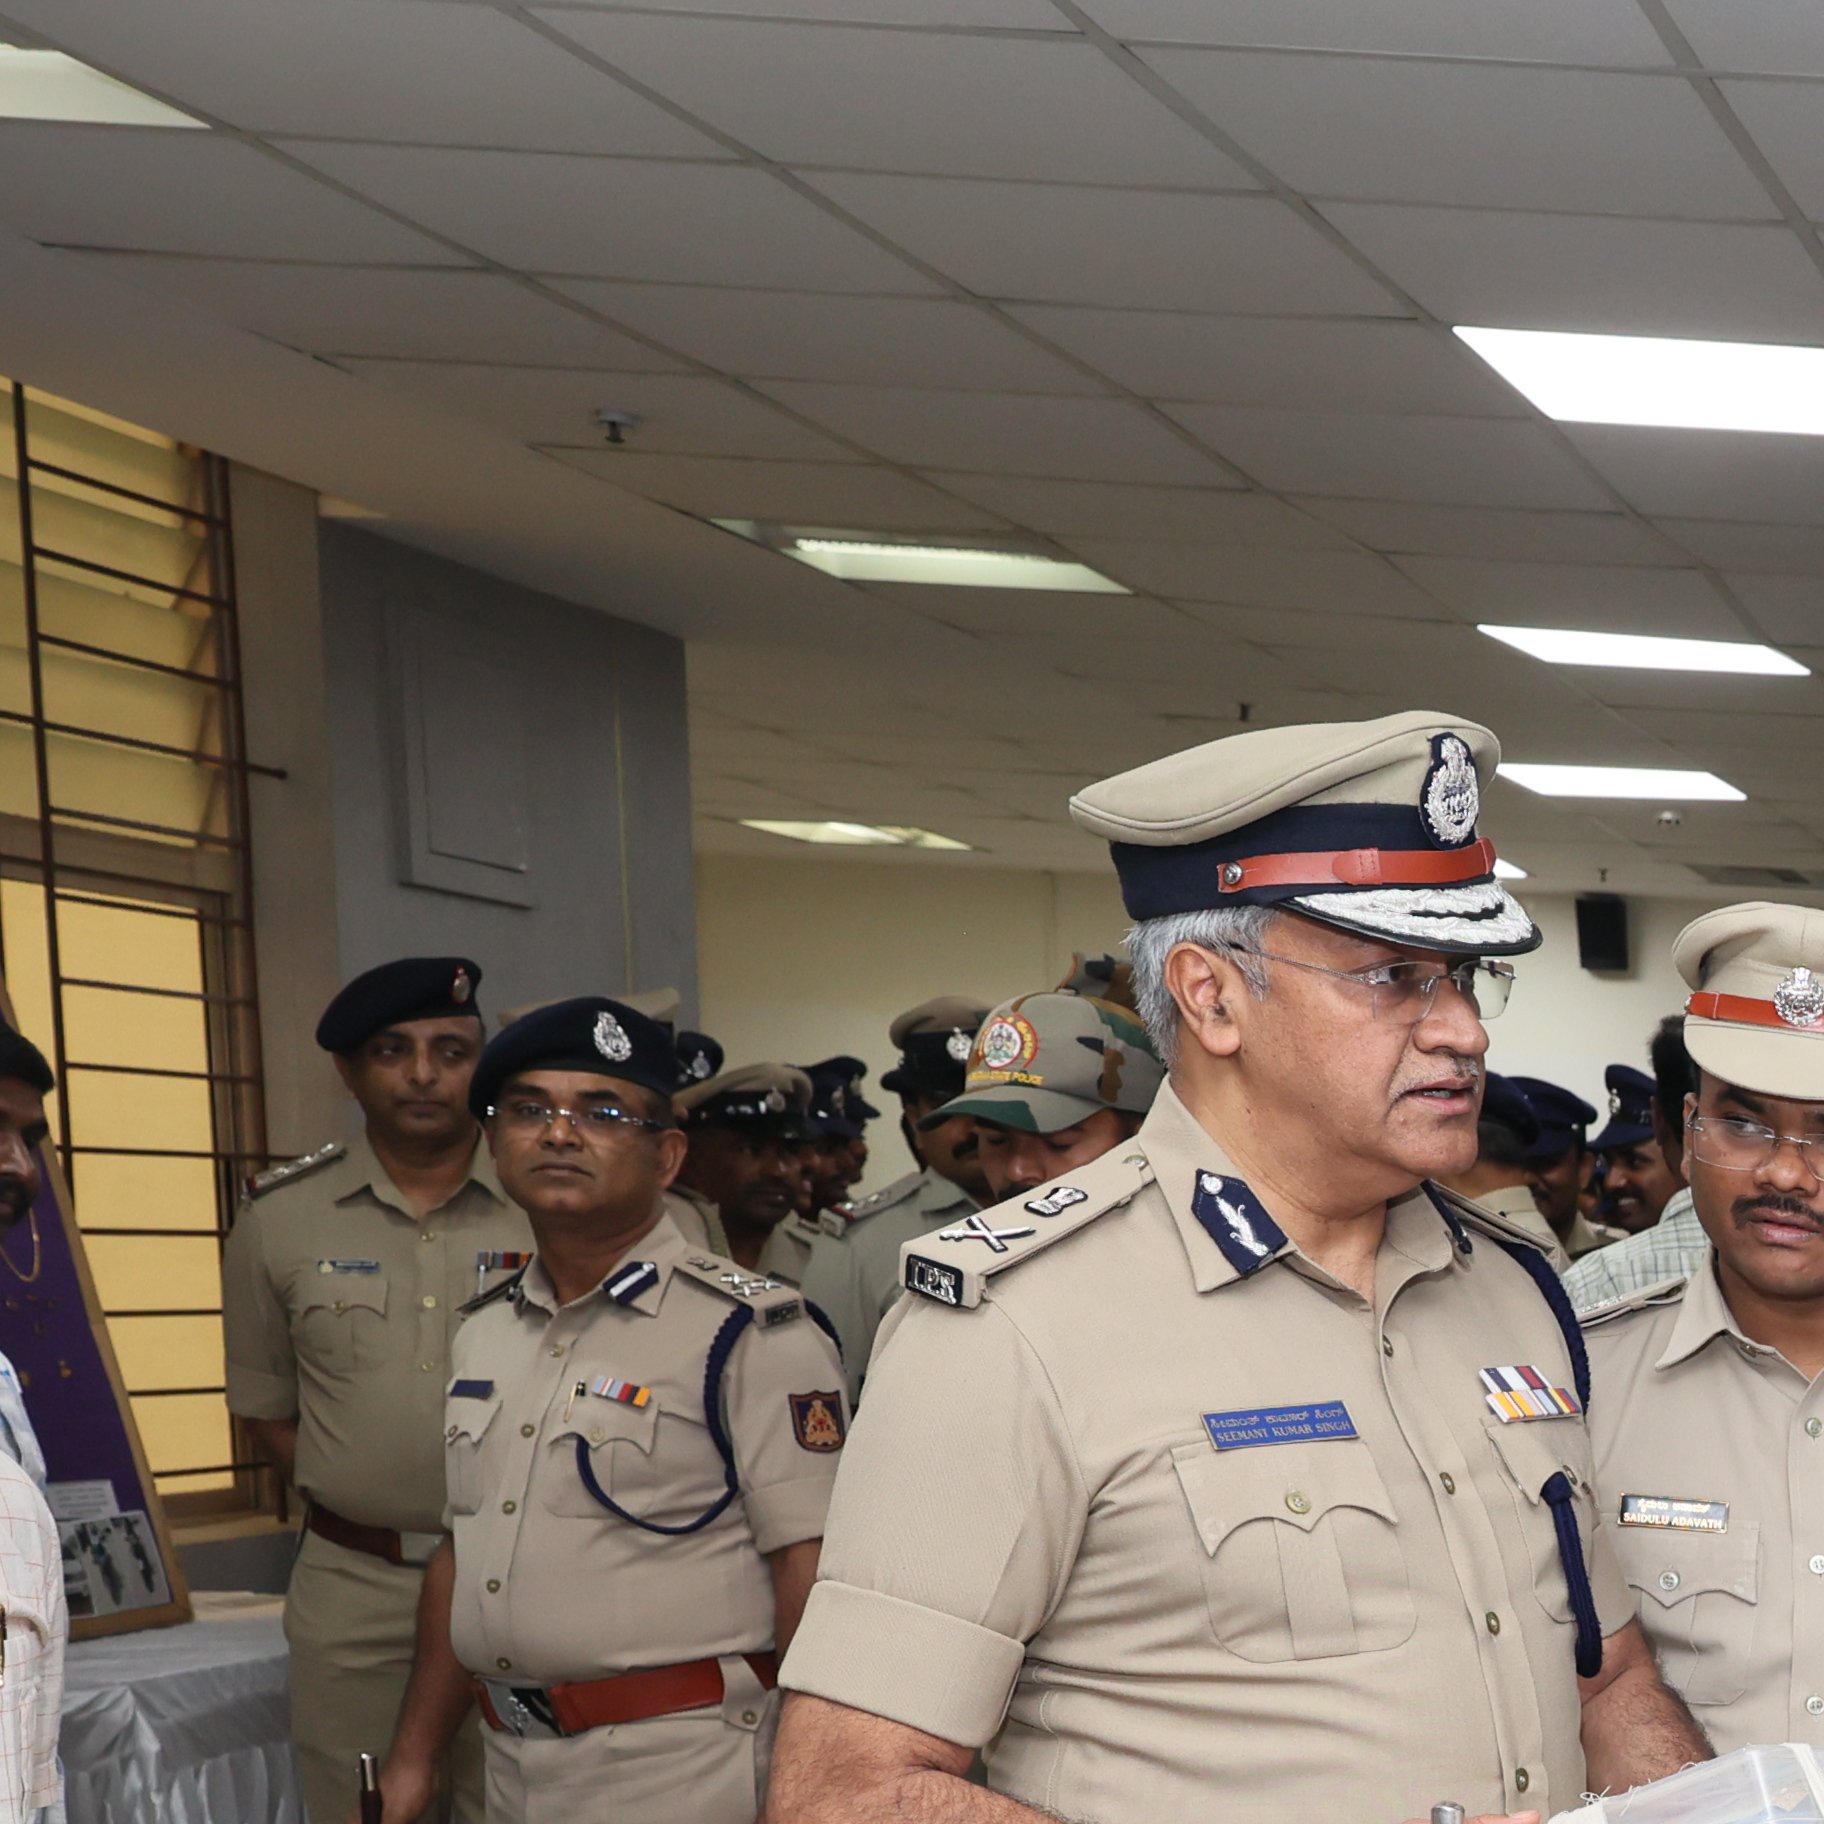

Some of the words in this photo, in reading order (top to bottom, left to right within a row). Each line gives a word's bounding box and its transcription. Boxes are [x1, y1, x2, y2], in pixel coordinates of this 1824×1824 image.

[1216, 1428, 1269, 1443] SEEMANT
[1272, 1423, 1313, 1437] KUMAR
[1315, 1420, 1351, 1433] SINGH
[1623, 1512, 1670, 1525] SAIDULU
[1671, 1516, 1723, 1529] ADAVATH
